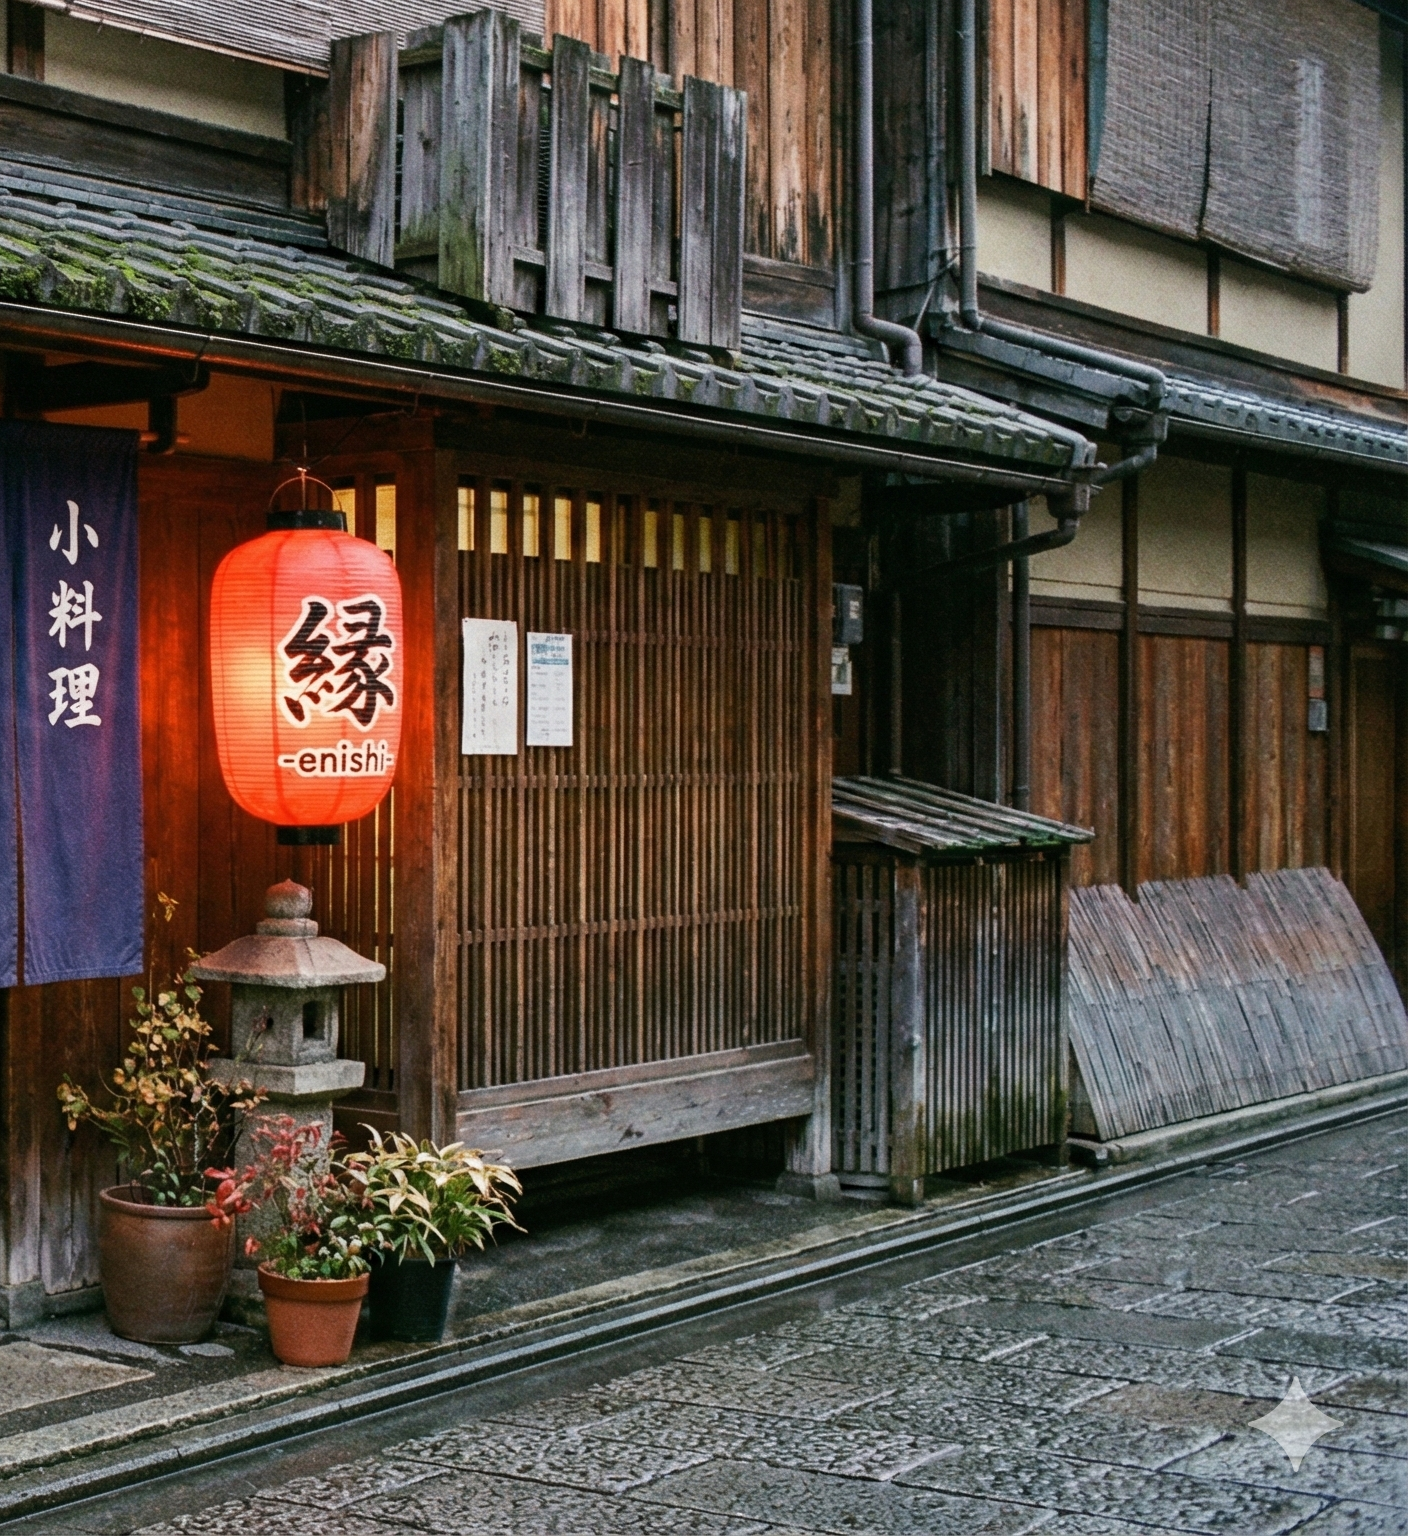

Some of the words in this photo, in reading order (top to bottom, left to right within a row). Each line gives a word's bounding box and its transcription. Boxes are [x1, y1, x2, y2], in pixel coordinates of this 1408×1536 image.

[48, 501, 102, 728] 小料理
[284, 600, 393, 727] 縁
[283, 743, 393, 773] -enishi-
